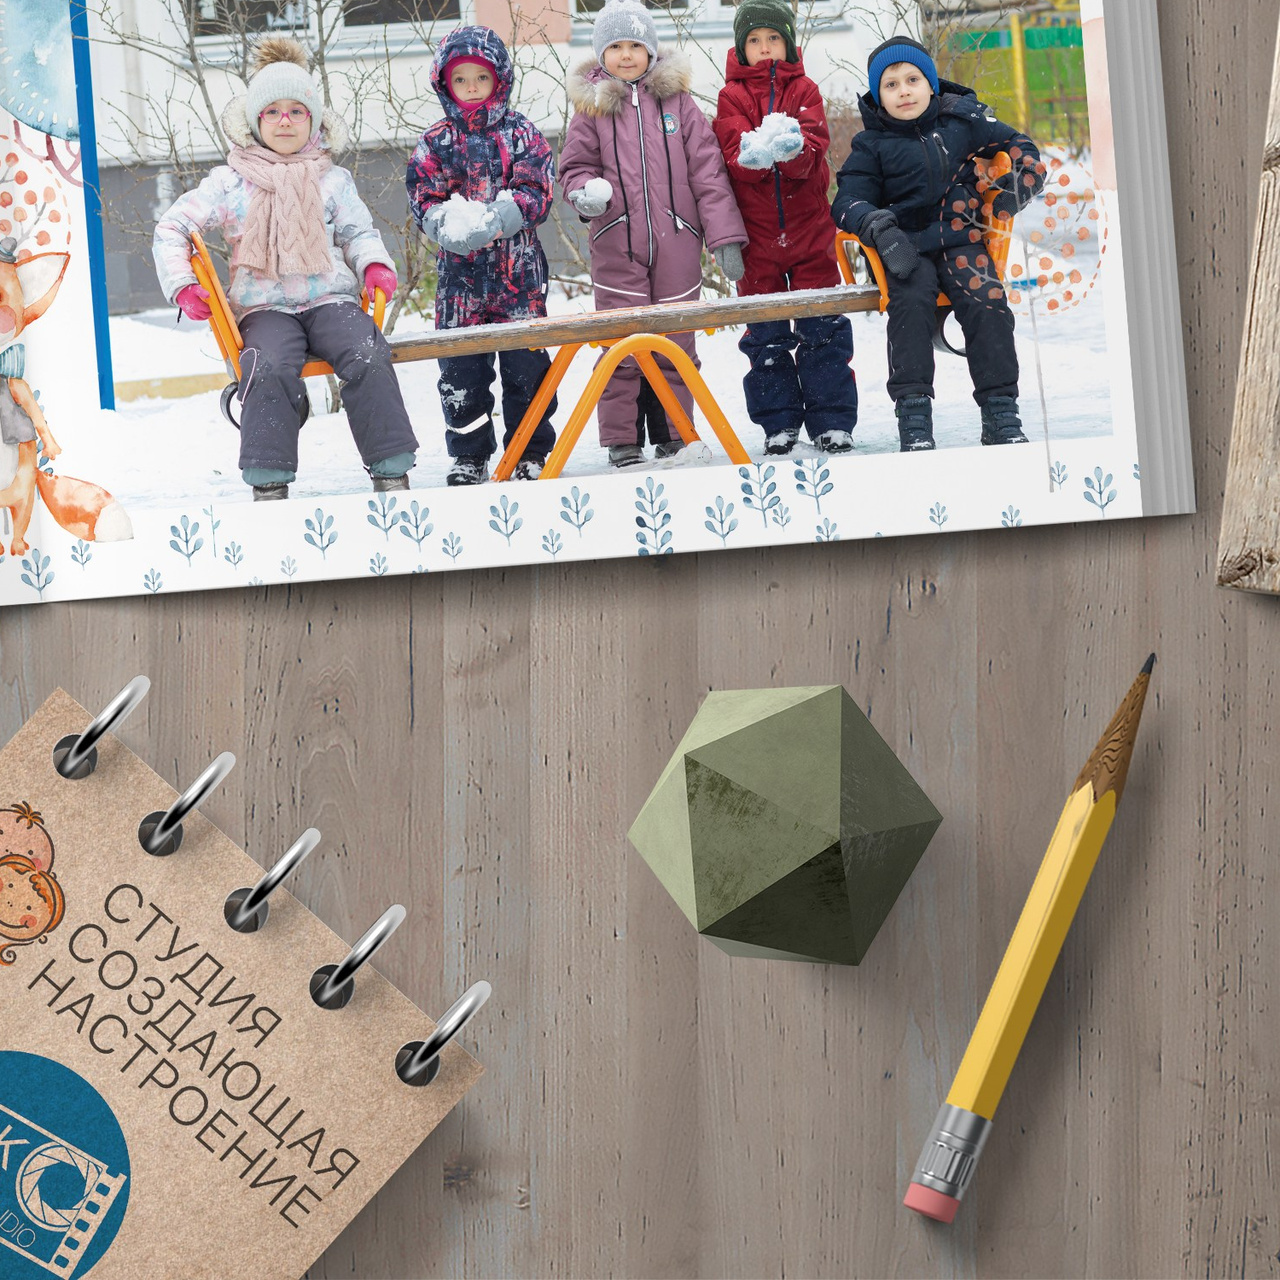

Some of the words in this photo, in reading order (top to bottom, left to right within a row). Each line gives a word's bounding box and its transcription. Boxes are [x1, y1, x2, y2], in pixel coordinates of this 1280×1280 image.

[27, 958, 323, 1229] НАСТРОЕНИЕ
[68, 923, 361, 1191] СОЗДАЮЩАЯ
[103, 883, 283, 1049] СТУДИЯ
